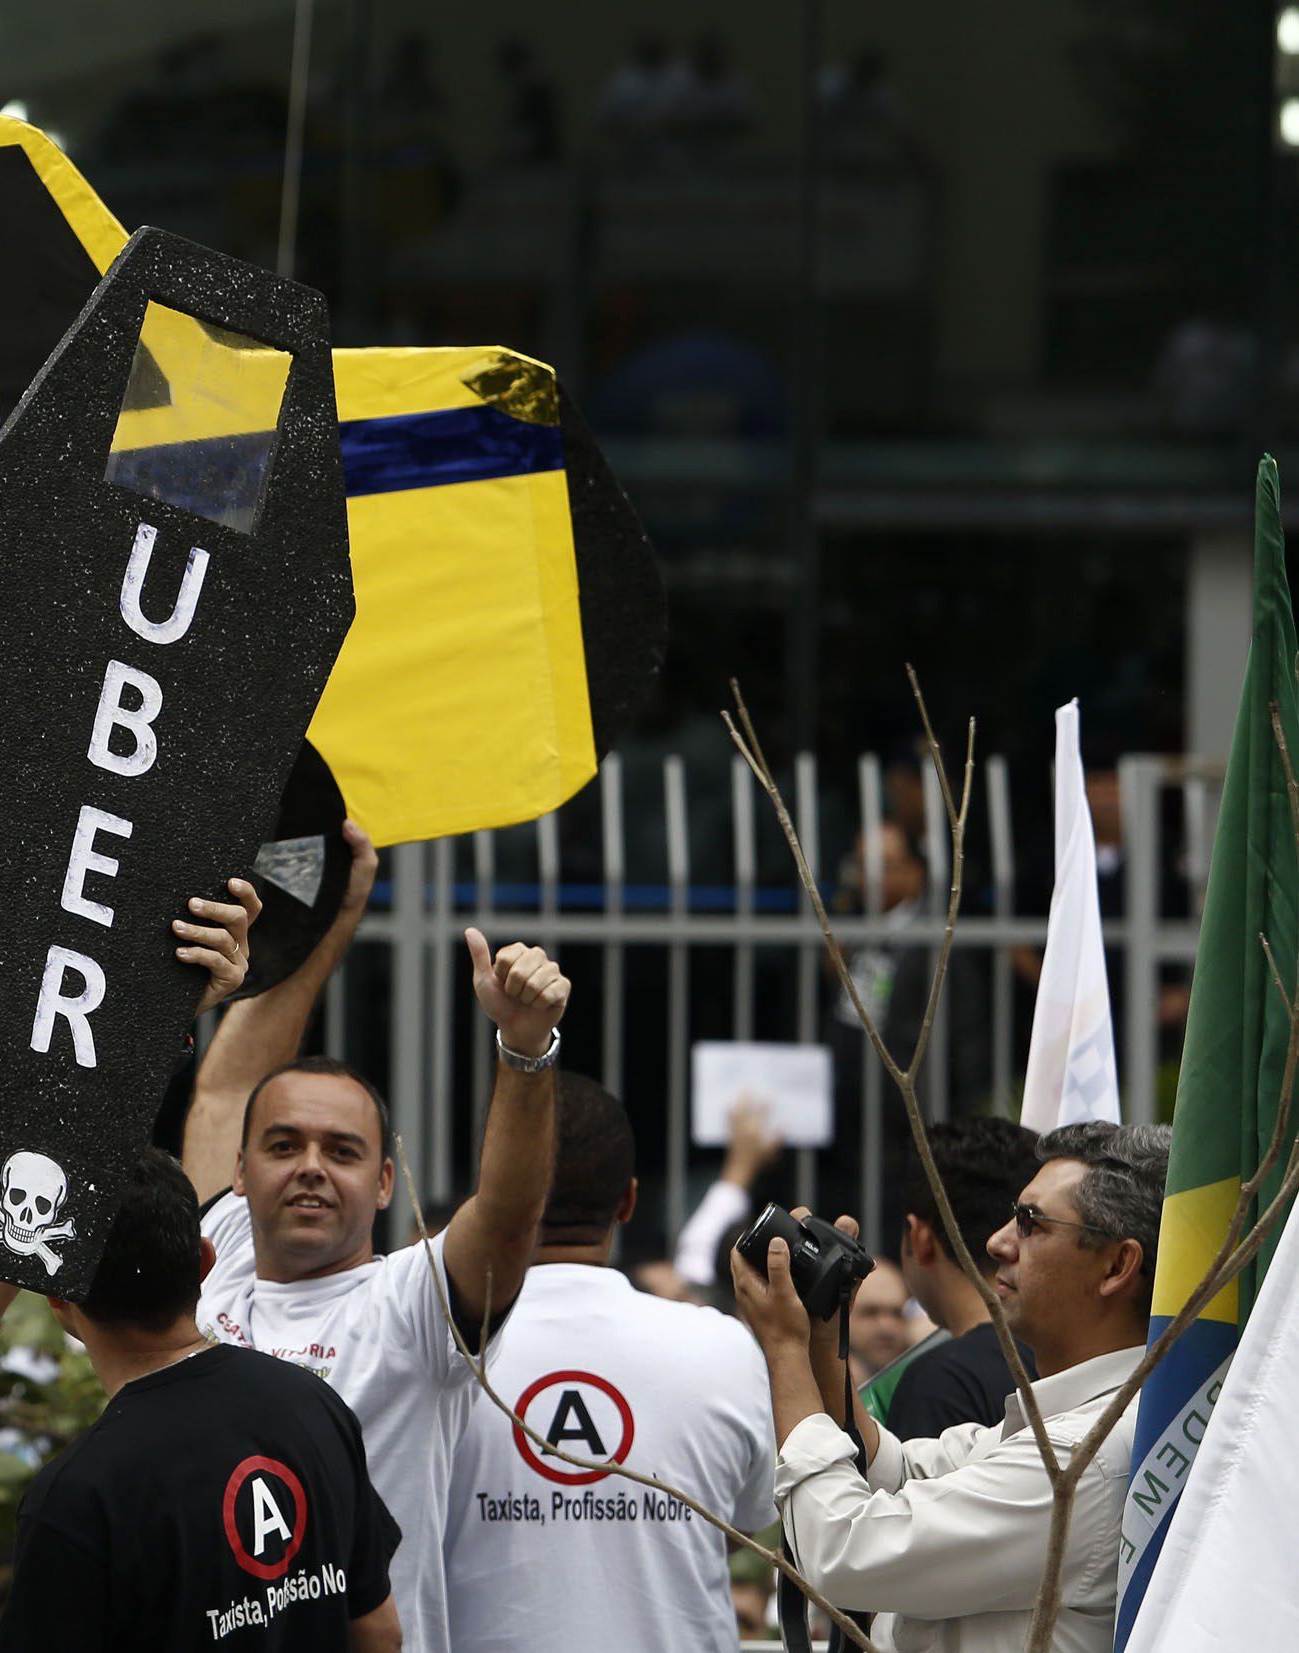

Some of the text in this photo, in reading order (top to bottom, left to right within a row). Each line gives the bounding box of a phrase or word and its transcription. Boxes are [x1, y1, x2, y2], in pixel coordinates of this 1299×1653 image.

[30, 522, 210, 1069] UBER
[540, 1390, 607, 1455] A
[252, 1477, 292, 1556] A
[476, 1491, 692, 1526] Taxista, Profissão Nobre
[206, 1596, 268, 1640] Taxista,
[322, 1563, 347, 1596] No
